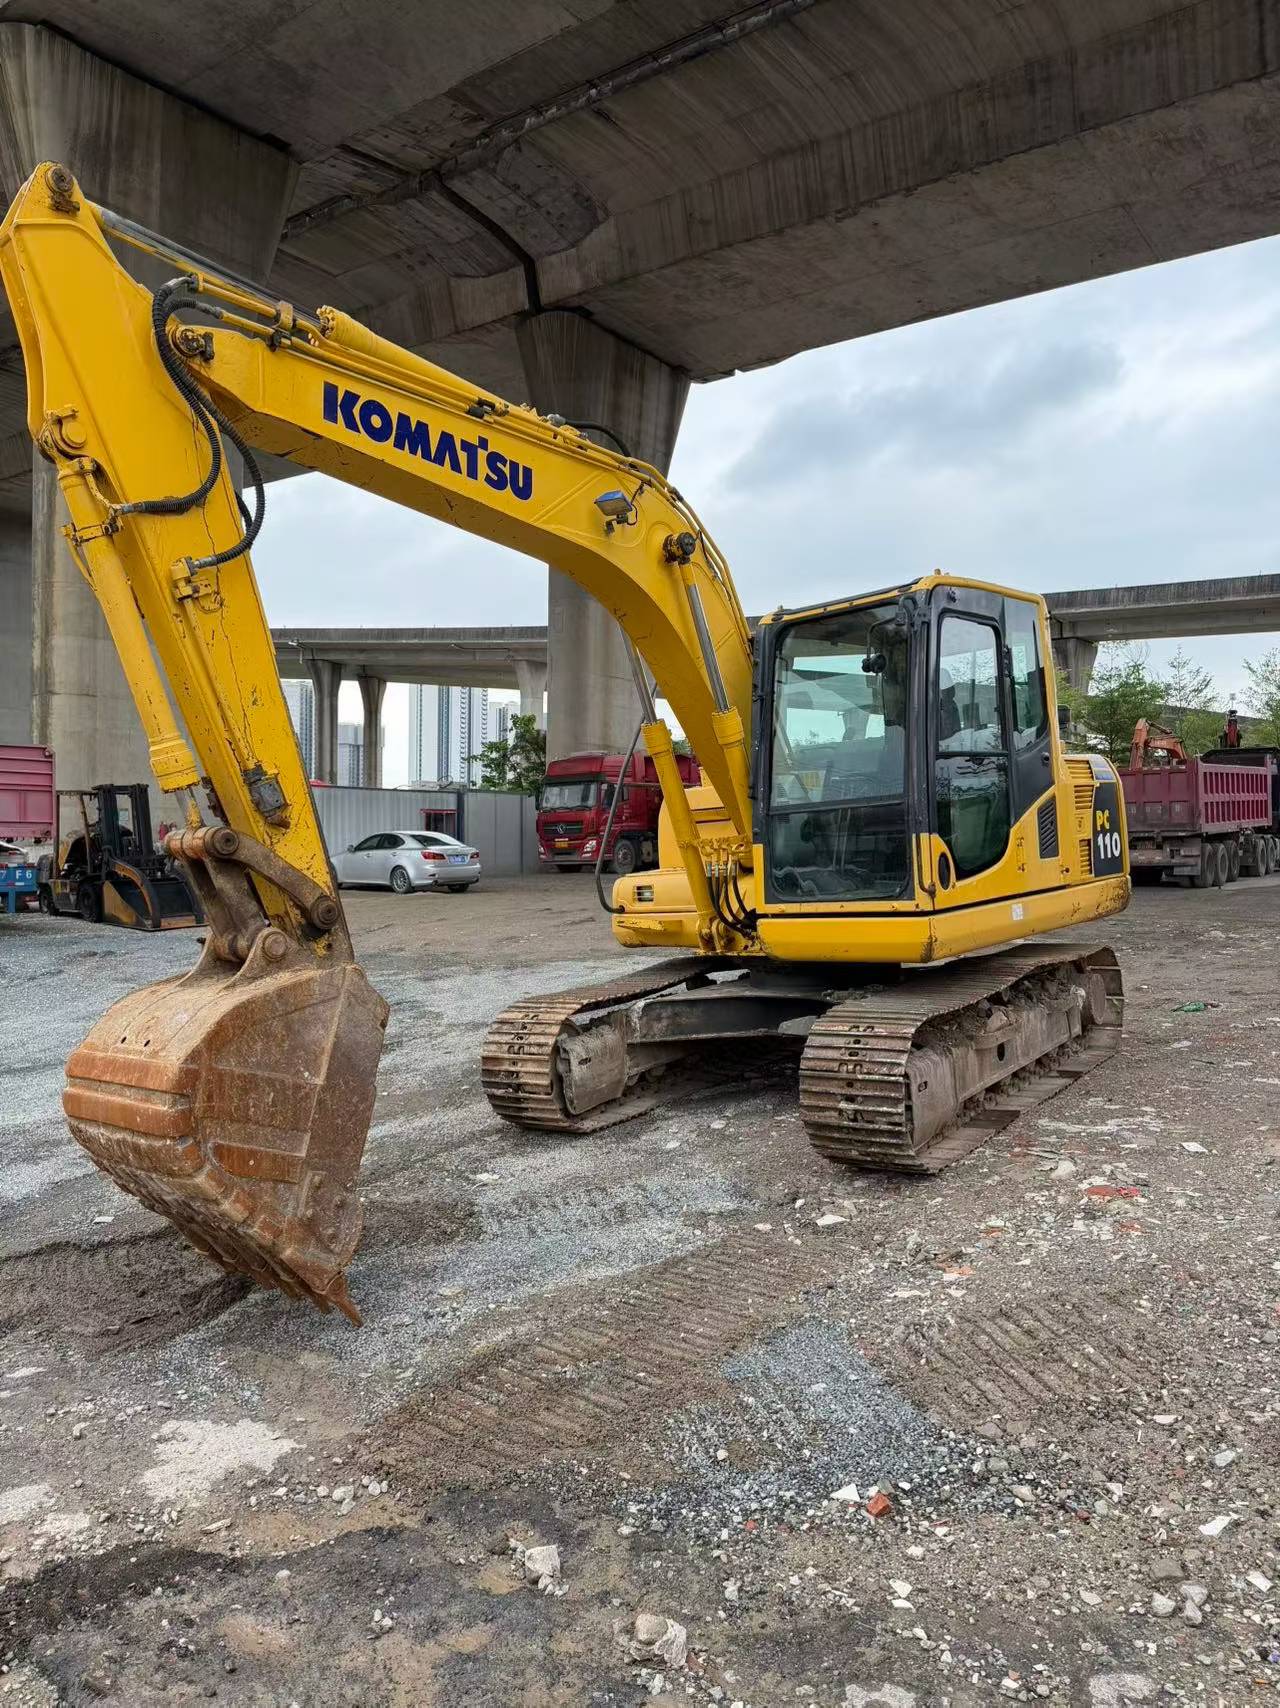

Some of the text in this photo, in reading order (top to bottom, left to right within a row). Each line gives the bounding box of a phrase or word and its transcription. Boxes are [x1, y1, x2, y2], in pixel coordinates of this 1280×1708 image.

[323, 380, 533, 501] KOMATSU
[1096, 809, 1110, 831] PC
[1097, 832, 1121, 859] 110
